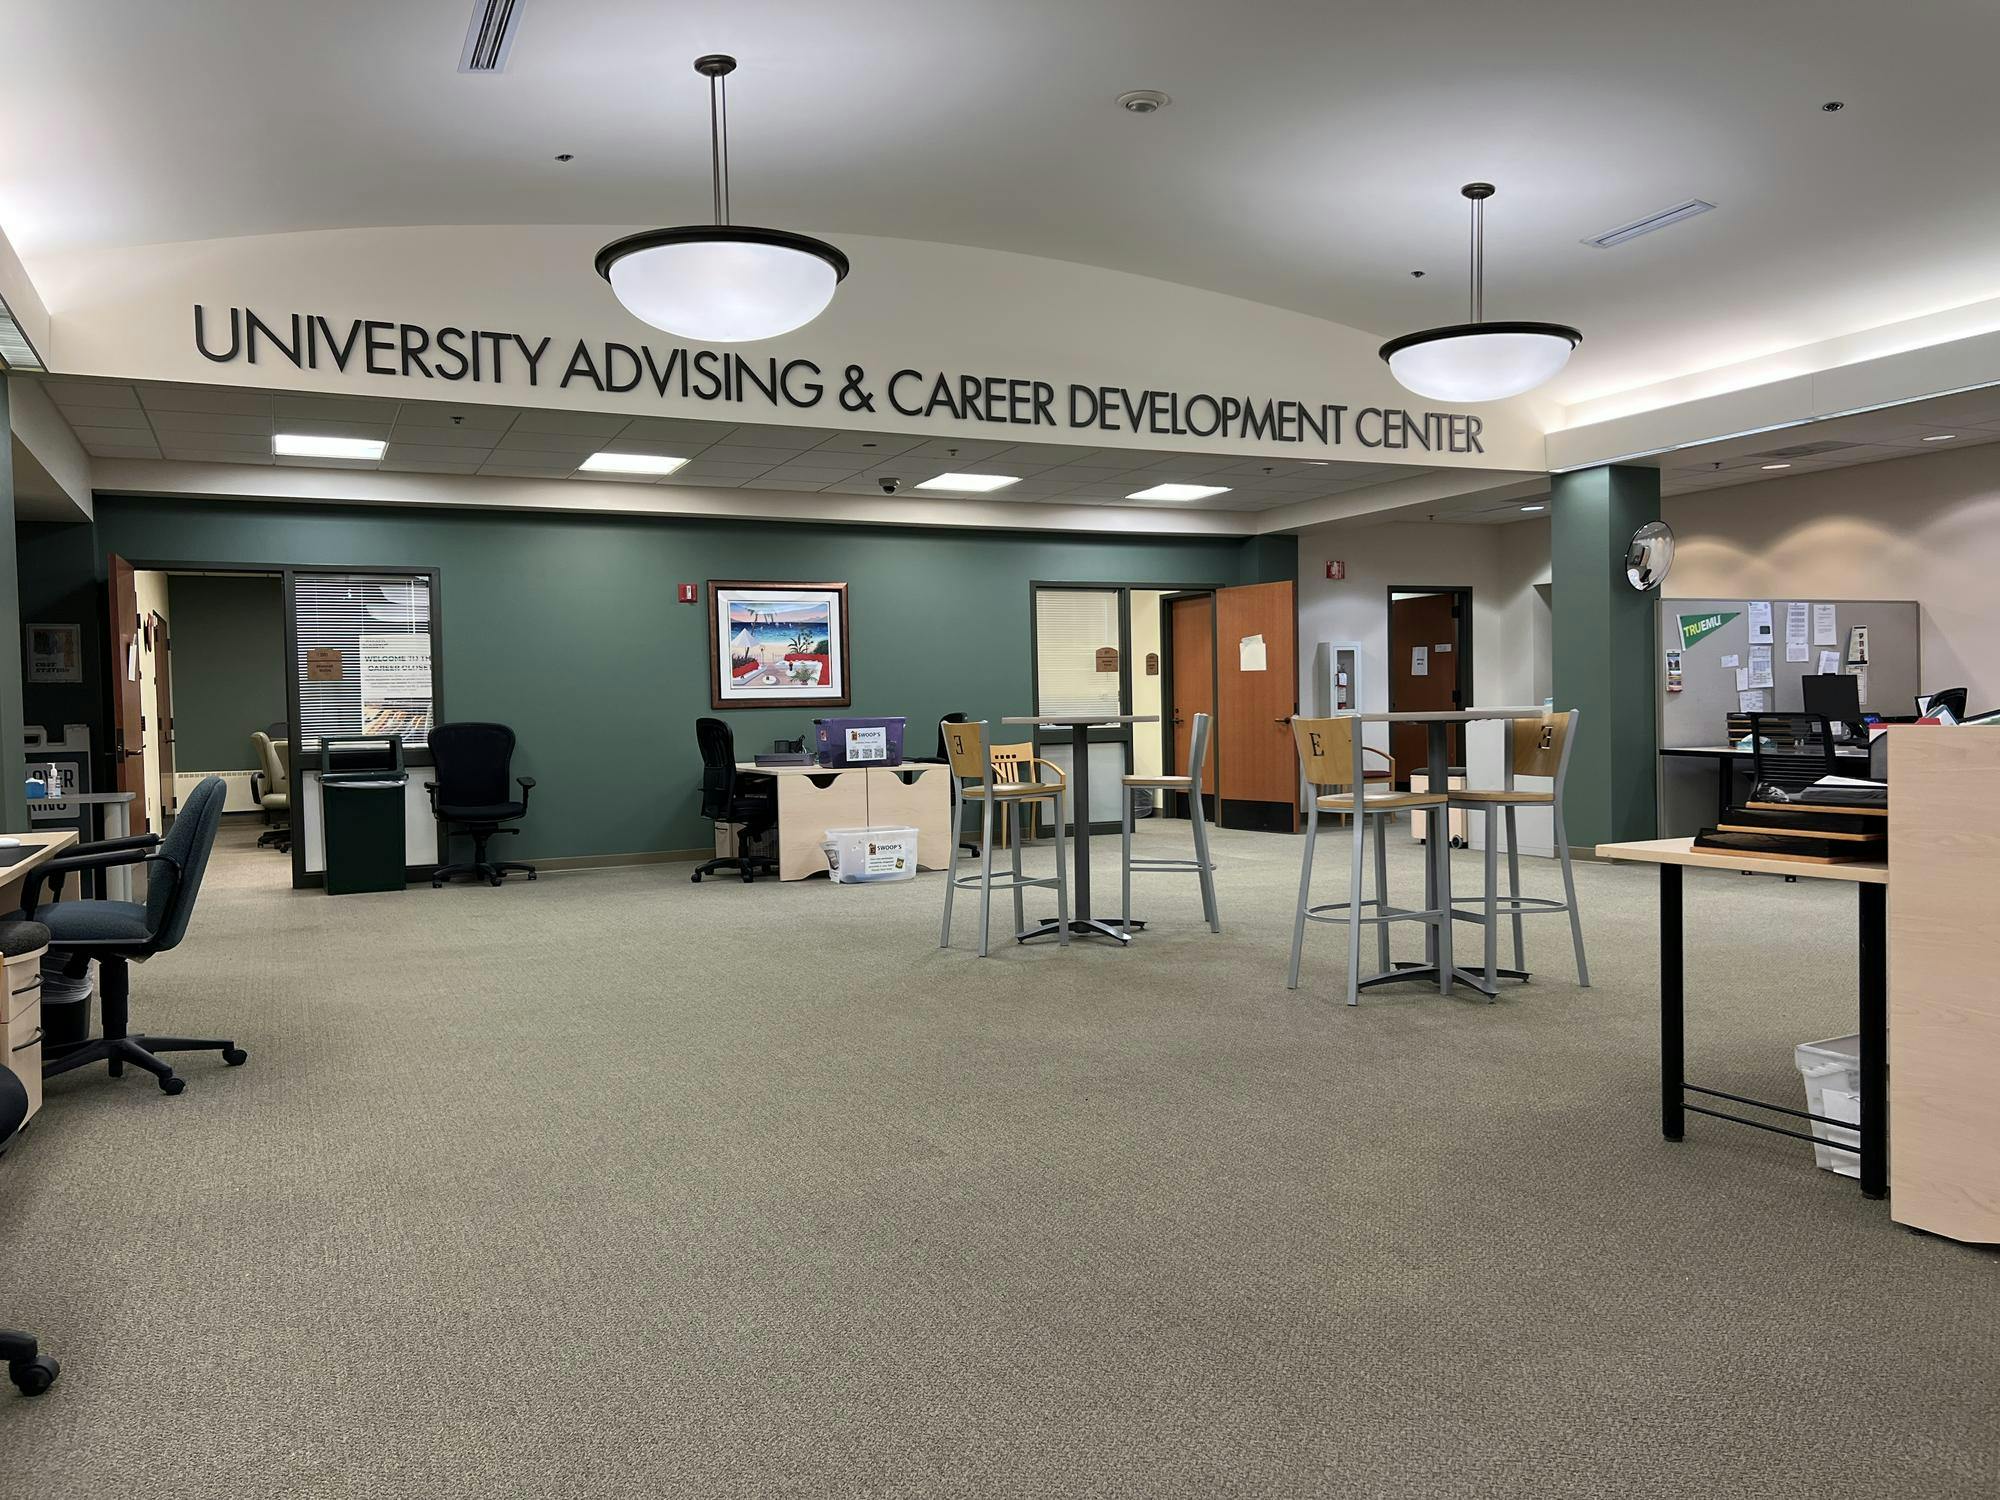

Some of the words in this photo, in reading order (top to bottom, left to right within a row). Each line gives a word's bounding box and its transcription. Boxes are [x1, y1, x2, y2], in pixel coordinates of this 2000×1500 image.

[193, 304, 550, 387] UNIVERSITY
[560, 338, 825, 409] ADVISING
[838, 365, 876, 414] &
[888, 369, 1058, 425] CAREER
[1069, 384, 1348, 446] DEVELOPMENT
[1355, 407, 1485, 454] CENTER
